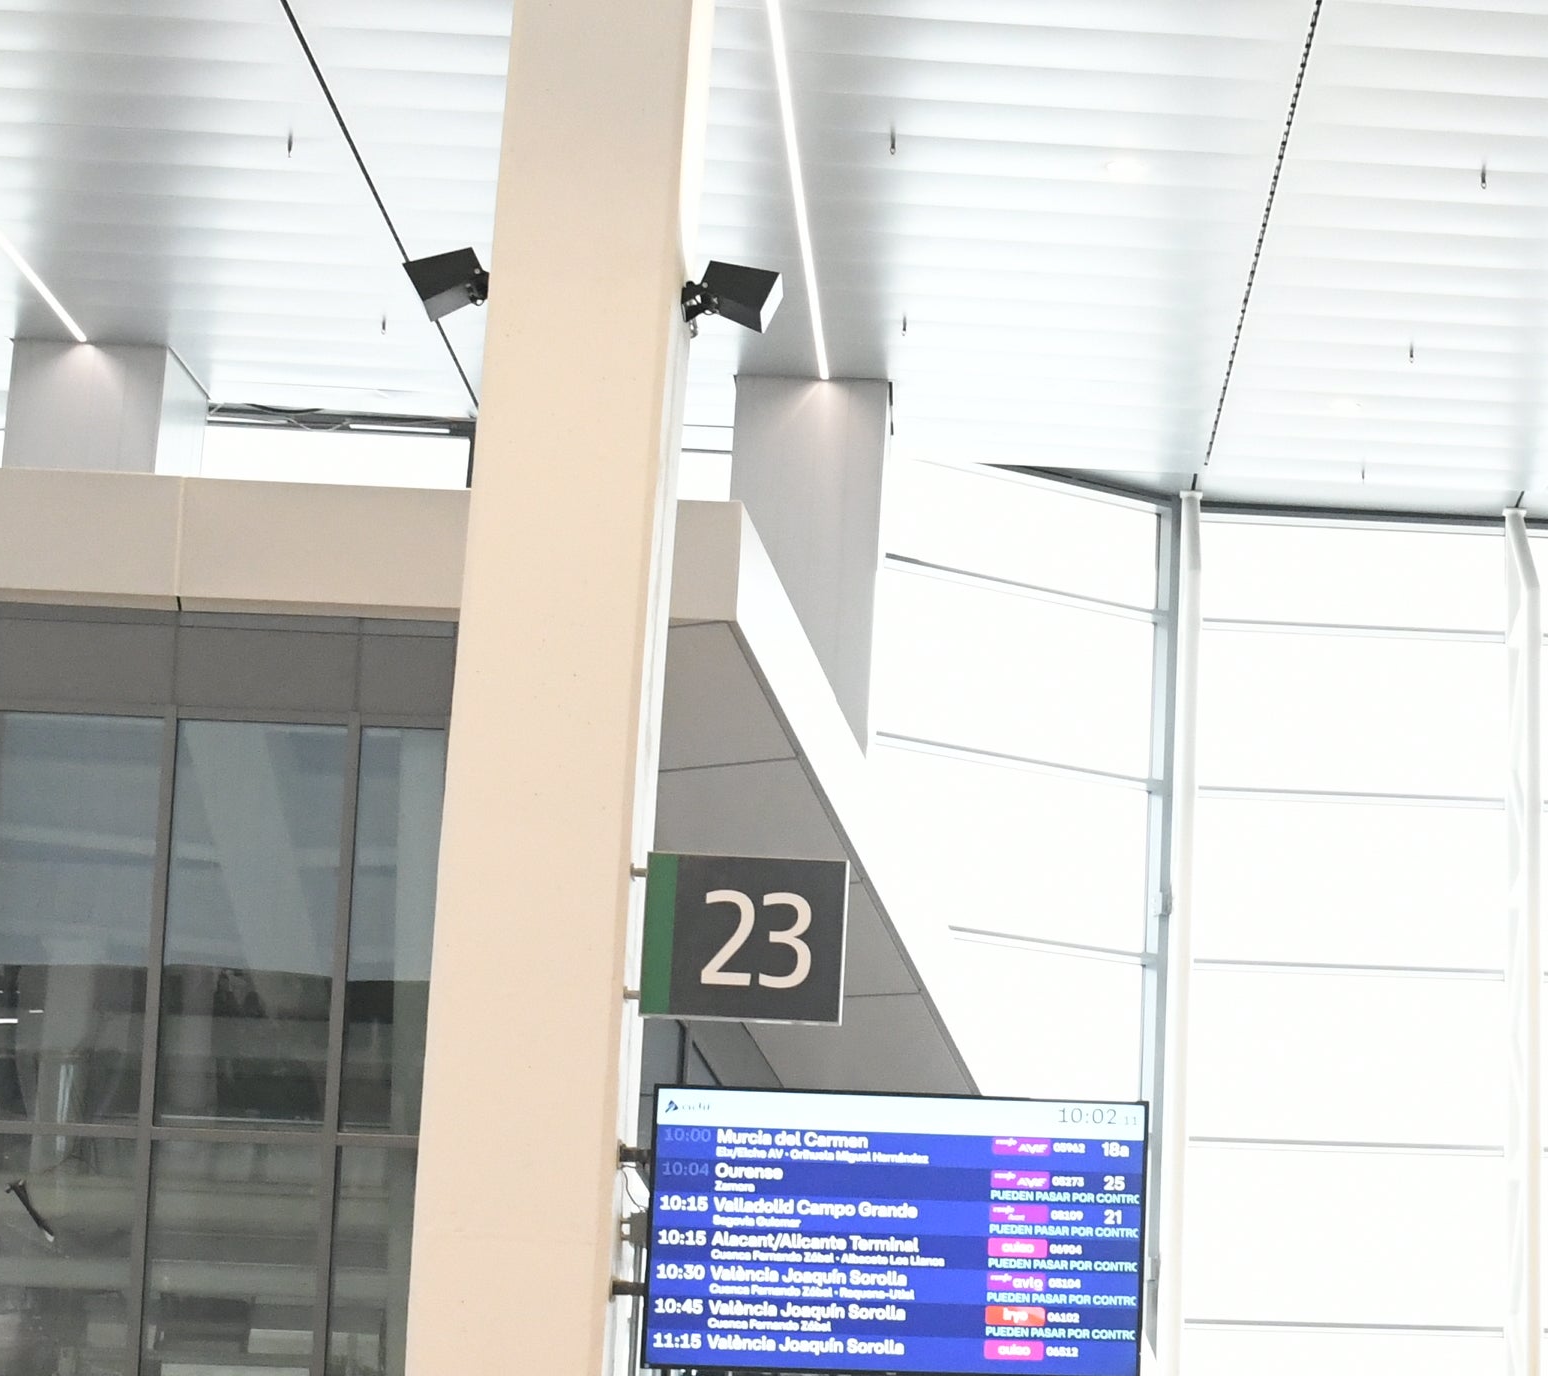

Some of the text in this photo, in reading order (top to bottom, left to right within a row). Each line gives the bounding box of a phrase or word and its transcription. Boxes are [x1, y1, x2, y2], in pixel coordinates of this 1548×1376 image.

[700, 889, 813, 989] 23
[1058, 1107, 1116, 1124] 10:02
[663, 1128, 711, 1142] 10:00
[716, 1128, 773, 1144] Murcia
[774, 1130, 802, 1145] del
[803, 1131, 869, 1148] Carmen
[1101, 1141, 1129, 1157] 18a
[661, 1161, 710, 1176] 10:04
[714, 1162, 784, 1180] Ourense
[1103, 1175, 1125, 1191] 25
[990, 1189, 1094, 1203] PUEDEN PASAR POR
[659, 1195, 708, 1211] 10:15
[712, 1196, 794, 1214] Valladolid
[795, 1199, 855, 1219] Campo
[857, 1201, 918, 1218] Grande
[1103, 1209, 1122, 1225] 21
[657, 1229, 707, 1245] 10:15
[711, 1230, 847, 1253] Alacant/Alicante
[848, 1235, 919, 1252] Terminal
[988, 1223, 1093, 1236] PUEDEN PASAR POR
[656, 1263, 705, 1280] 10:30
[709, 1265, 780, 1282] València
[781, 1267, 847, 1287] Joaquín
[848, 1269, 907, 1286] Sorolla
[987, 1257, 1092, 1271] PUEDEN PASAR POR
[986, 1291, 1090, 1304] PUEDEN PASAR POR
[654, 1298, 703, 1314] 10:45
[707, 1299, 778, 1317] València
[780, 1301, 845, 1321] Joaquín
[847, 1304, 906, 1320] Sorolla
[984, 1325, 1089, 1339] PUEDEN PASAR POR
[652, 1332, 702, 1349] 11:15
[706, 1334, 777, 1351] València
[778, 1336, 844, 1356] Joaquín
[845, 1338, 904, 1355] Sorolla
